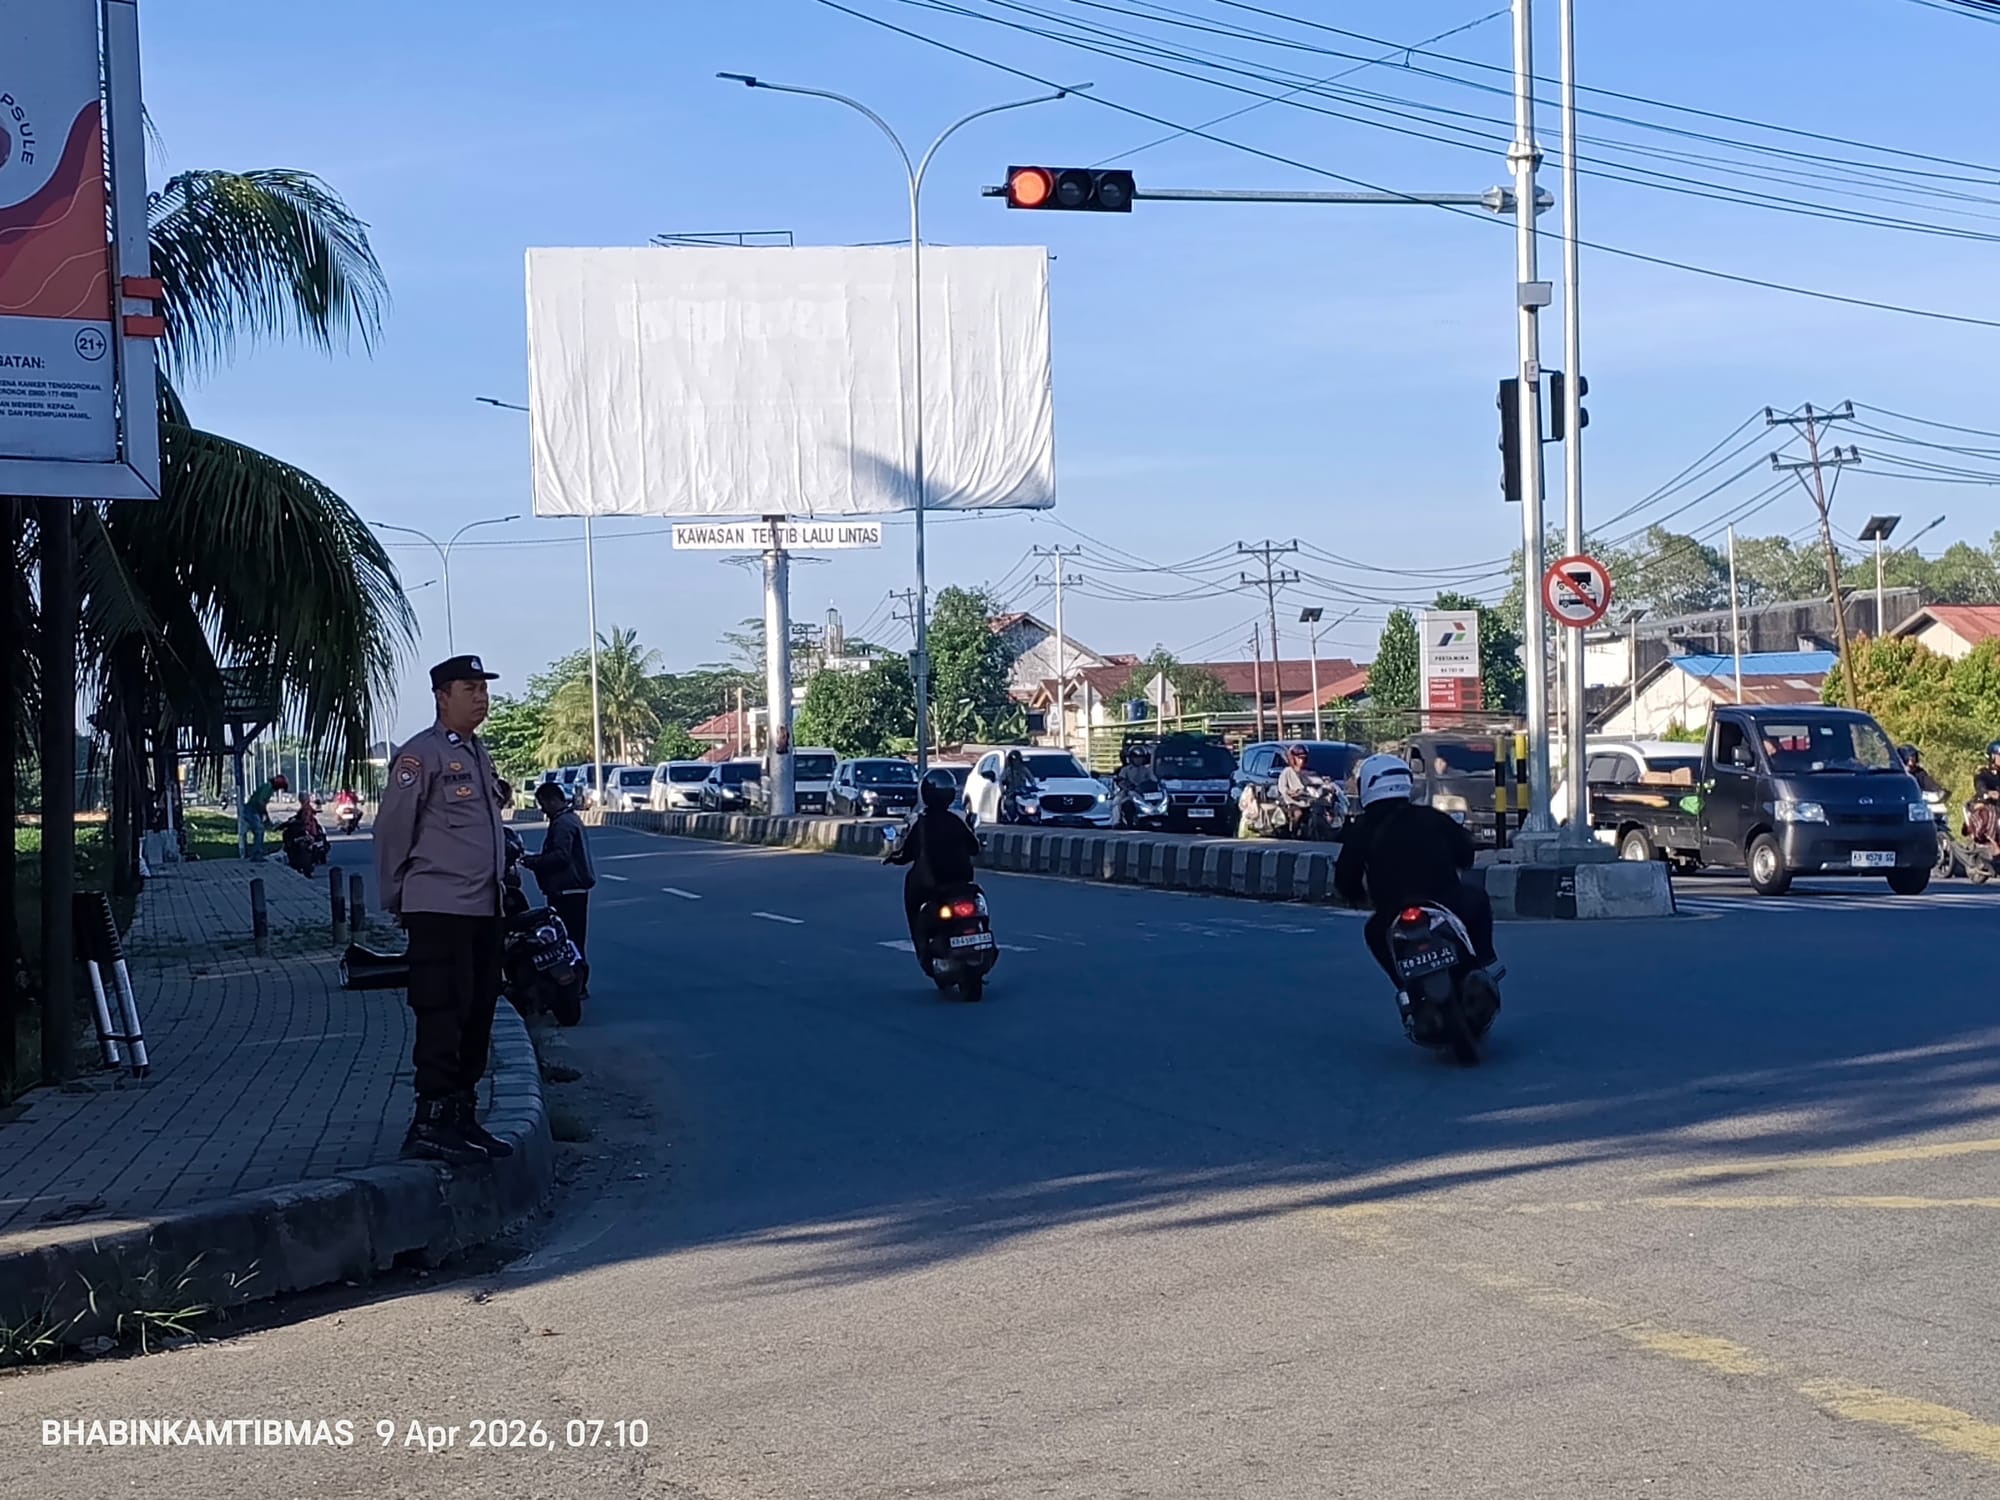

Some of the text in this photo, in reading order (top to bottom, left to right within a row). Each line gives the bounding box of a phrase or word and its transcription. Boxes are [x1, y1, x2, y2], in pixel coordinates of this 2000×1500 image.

[79, 337, 104, 351] 21+
[677, 528, 879, 545] KAWASAN TERTIB LALU LINTAS
